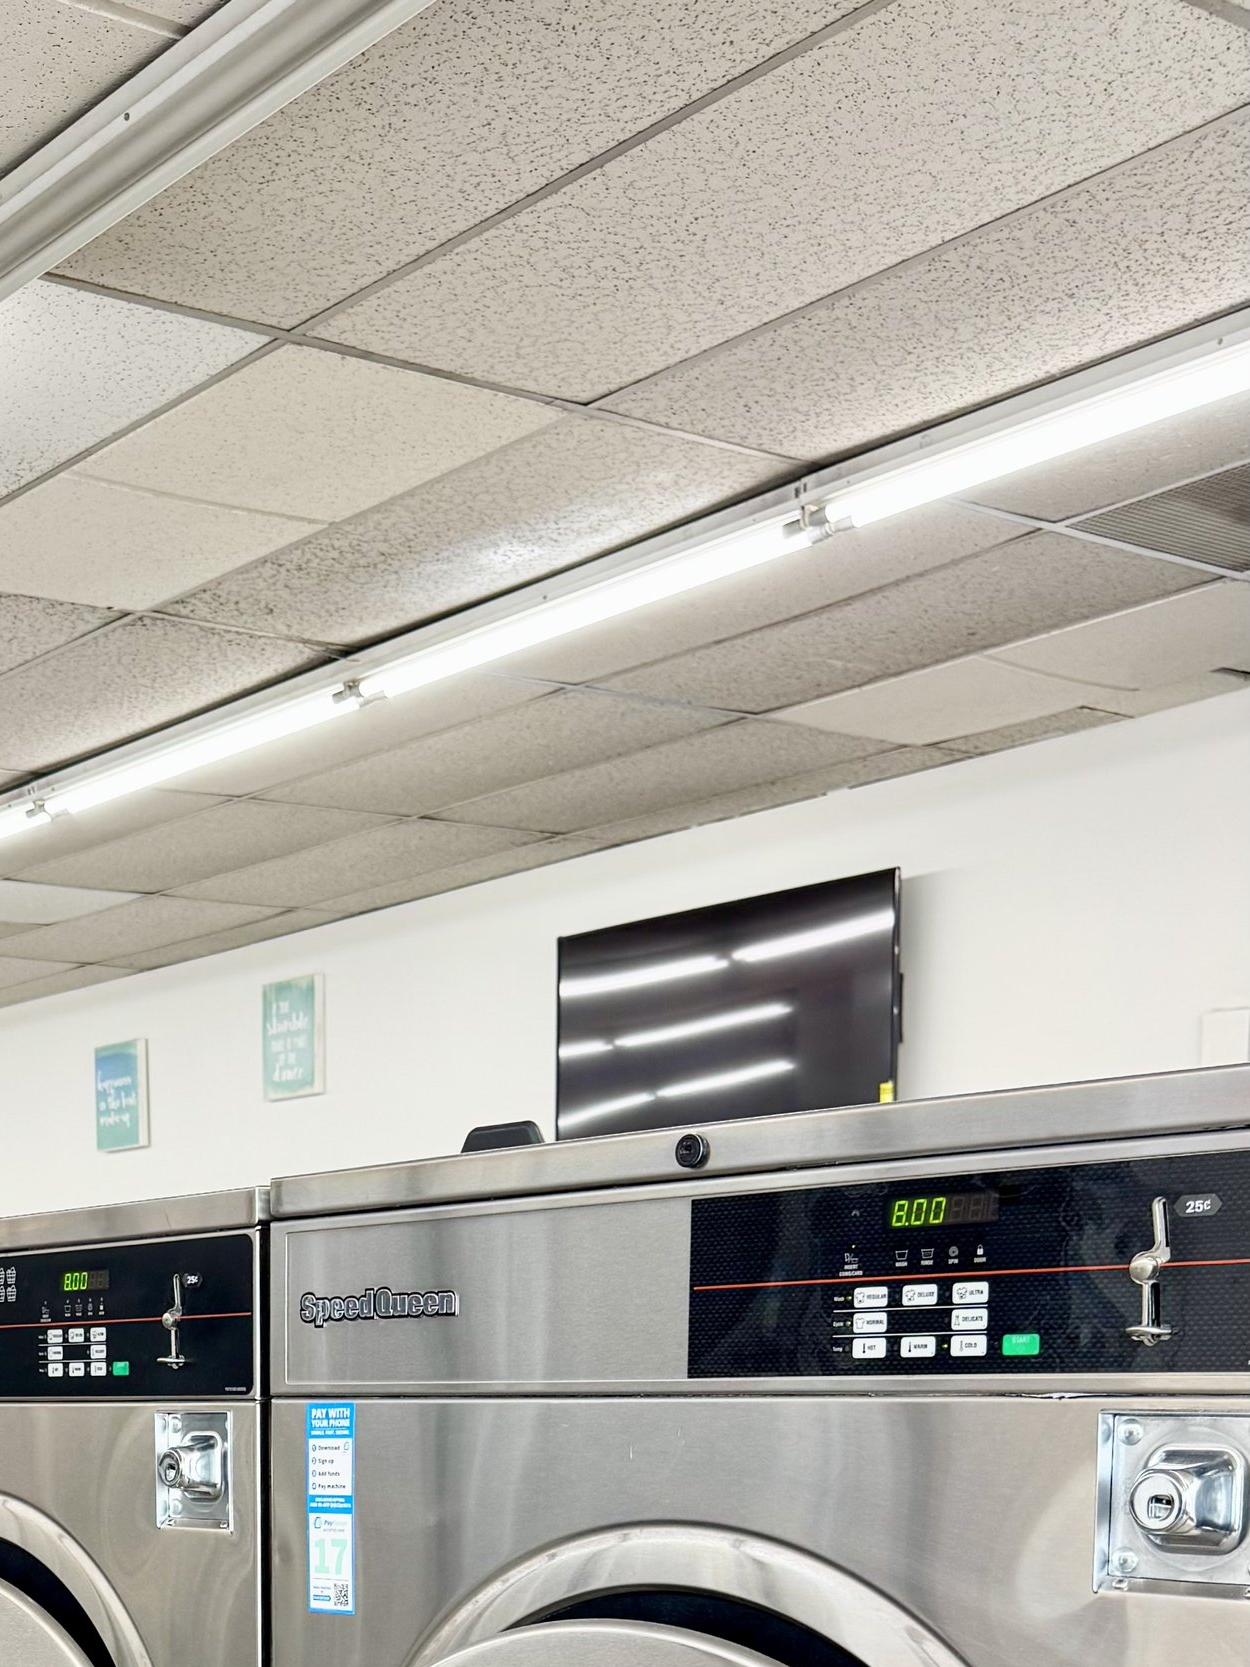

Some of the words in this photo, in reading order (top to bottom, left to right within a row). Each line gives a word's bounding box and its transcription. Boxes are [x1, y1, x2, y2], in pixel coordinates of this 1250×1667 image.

[891, 1196, 947, 1227] 8.00
[1185, 1198, 1211, 1214] 25¢
[300, 1287, 375, 1328] Speed
[375, 1286, 459, 1319] Queen
[311, 1407, 327, 1419] PAY
[327, 1407, 350, 1419] WITH
[313, 1538, 349, 1575] 17
